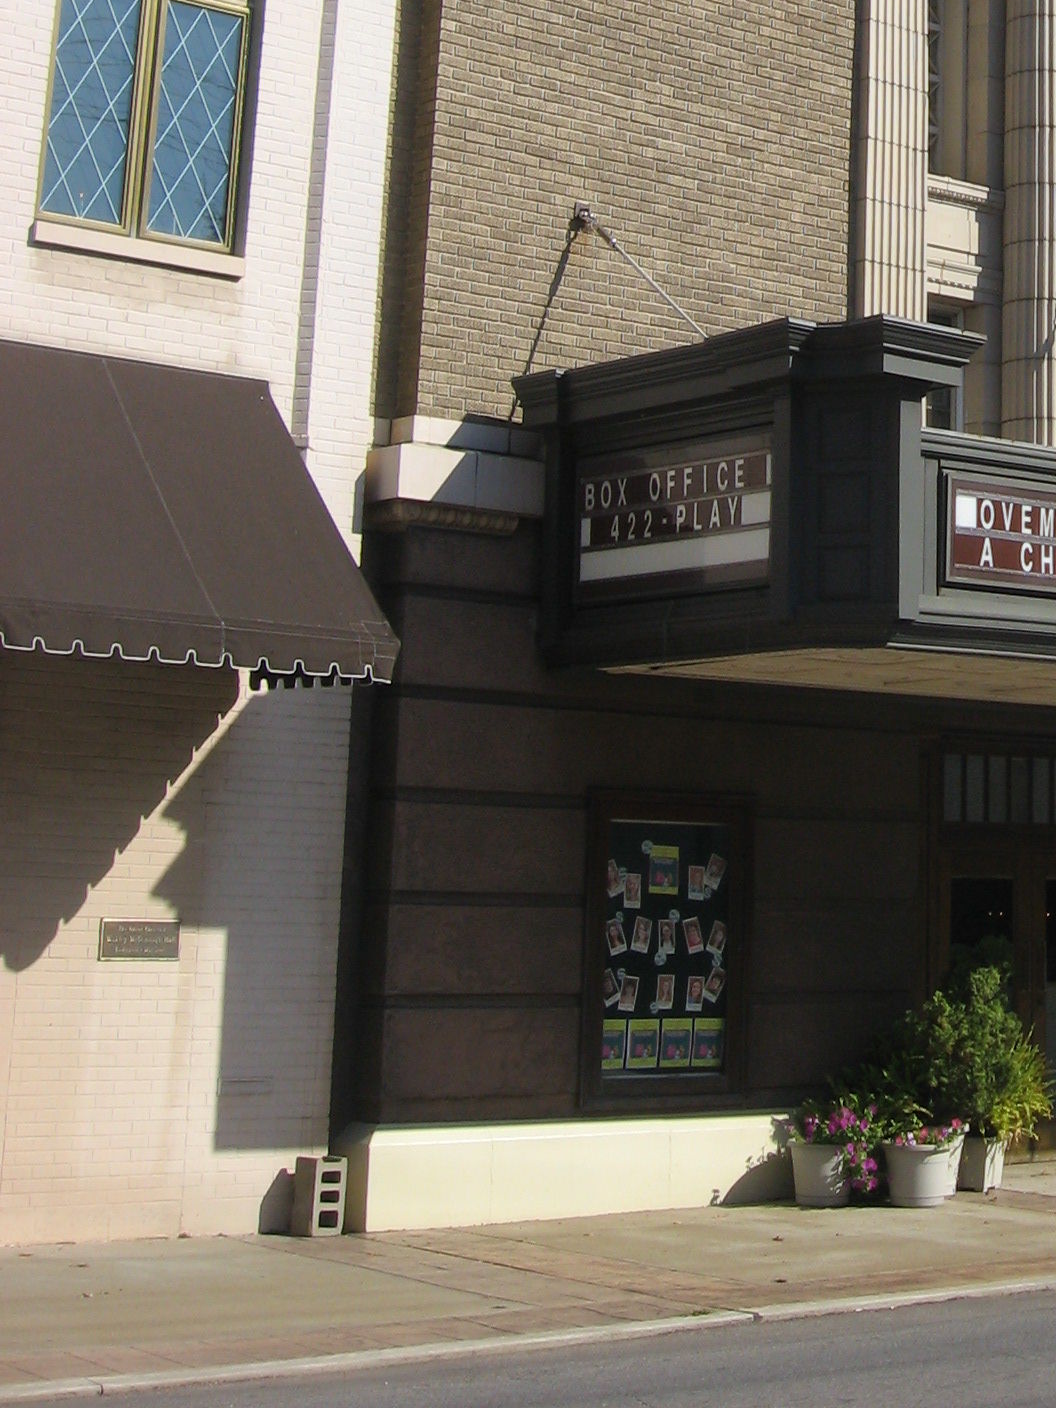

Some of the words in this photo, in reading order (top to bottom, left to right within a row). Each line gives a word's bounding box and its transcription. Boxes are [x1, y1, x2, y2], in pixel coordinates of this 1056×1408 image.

[585, 479, 628, 511] BOX
[649, 459, 745, 502] OFFICE
[980, 537, 994, 568] A
